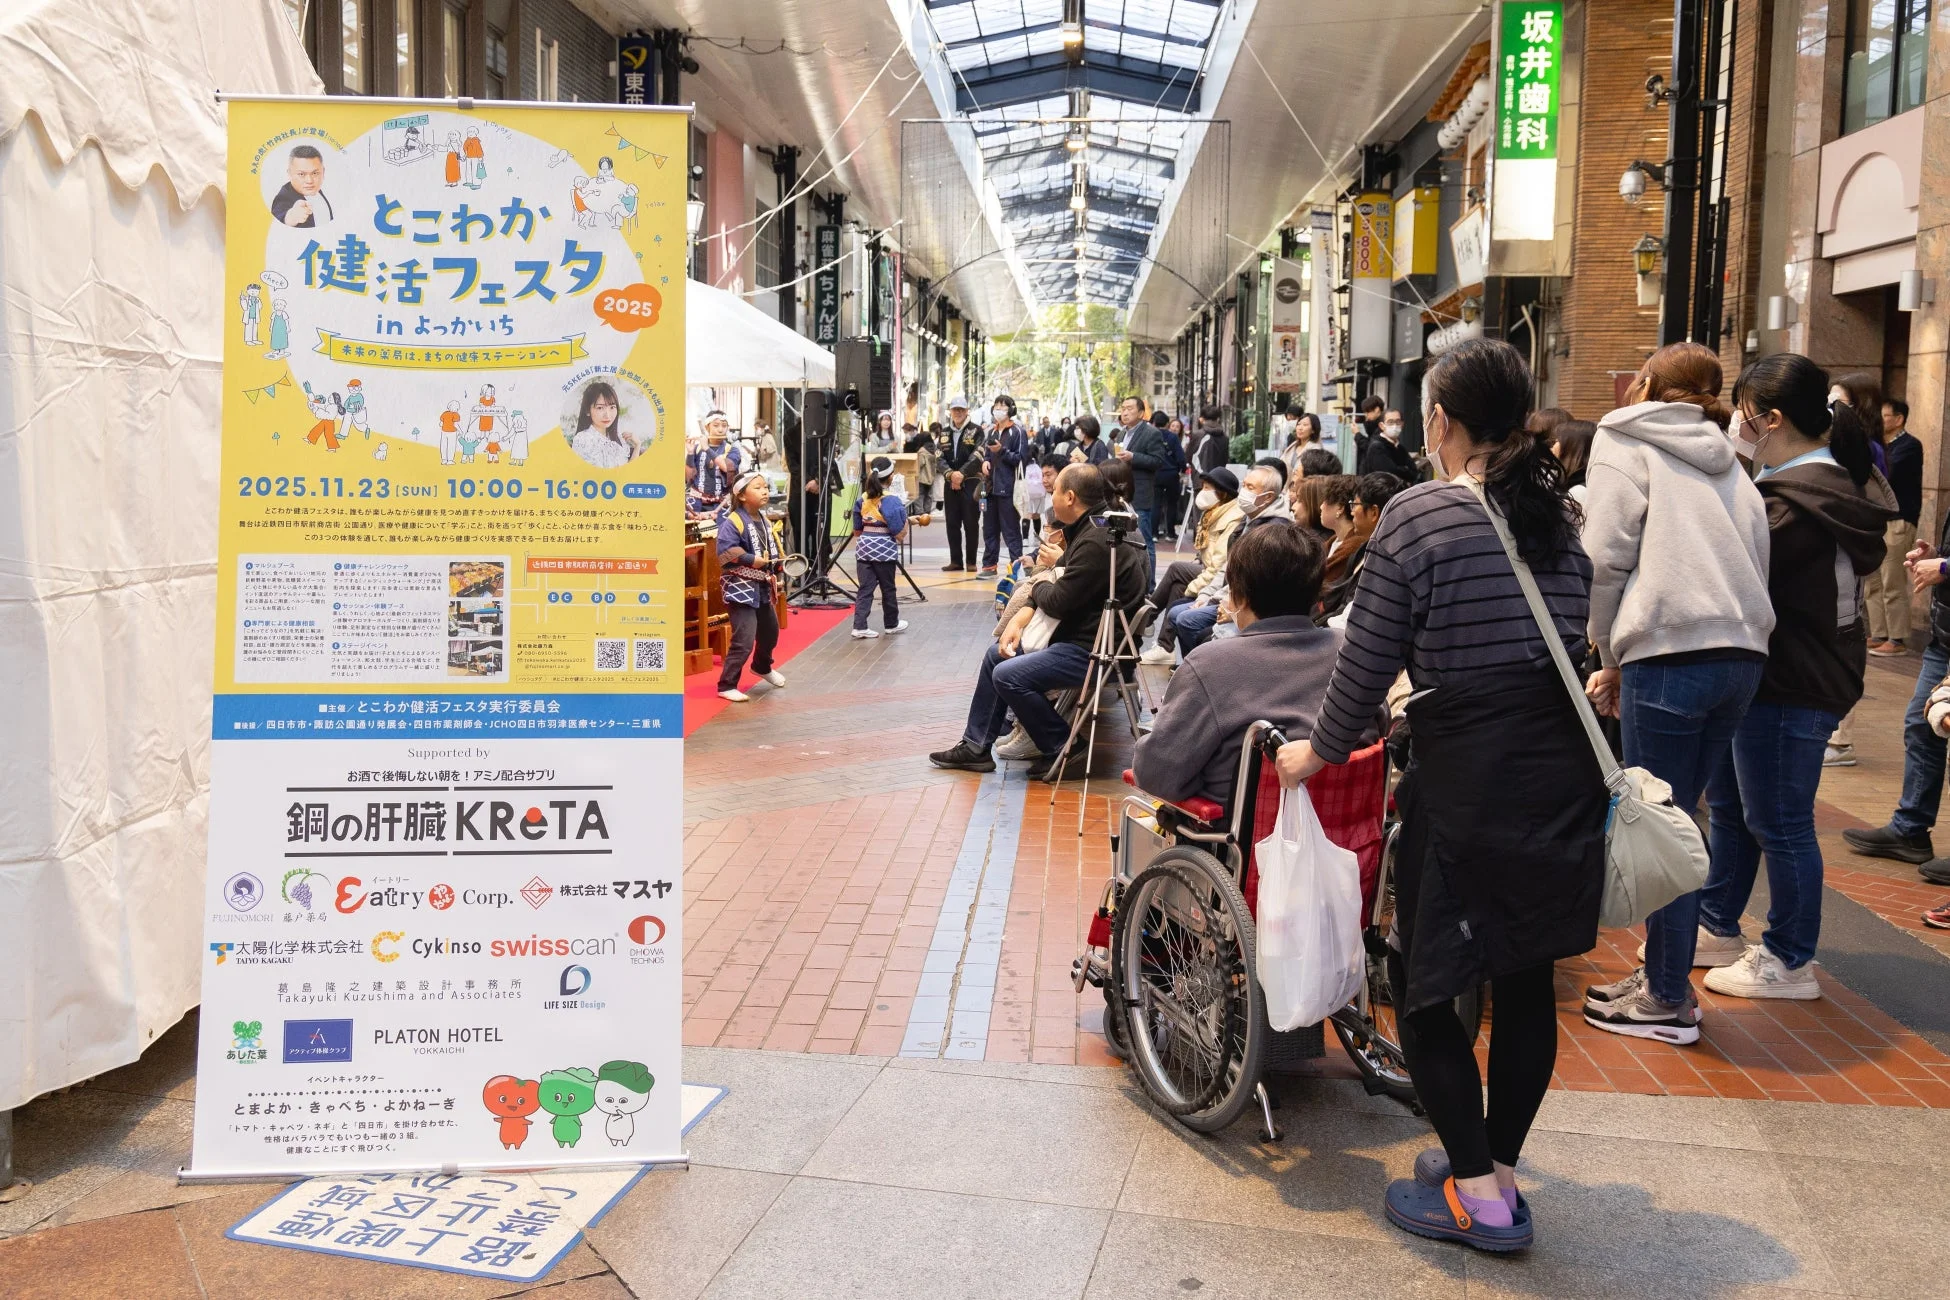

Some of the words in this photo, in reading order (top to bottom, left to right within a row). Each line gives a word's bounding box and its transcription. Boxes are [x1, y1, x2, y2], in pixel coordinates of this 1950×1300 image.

[1516, 10, 1554, 151] 坂井歯科
[373, 193, 553, 245] とこわか
[296, 233, 606, 306] 健活フェスタ
[263, 273, 285, 286] check
[603, 296, 652, 317] 2025
[376, 314, 403, 336] in
[414, 314, 514, 336] よっかいち
[342, 344, 561, 363] 未来の薬局は、まちの健康ステーションへ
[238, 476, 390, 498] 2025.11.23
[396, 485, 438, 498] [SUN]
[617, 561, 648, 570] 公園通り
[408, 747, 471, 760] Supported
[476, 747, 491, 760] by
[286, 801, 447, 842] 鋼の肝臓
[462, 889, 514, 908] Corp.
[560, 884, 608, 897] 株式会社
[612, 879, 673, 899] マスヤ
[212, 913, 274, 923] FUJINOMORI
[283, 912, 328, 923] 藤戸薬局
[236, 939, 364, 956] 太陽化学株式会社
[412, 937, 481, 958] Cykinso
[490, 934, 616, 957] swisscan
[629, 948, 665, 957] DHOWA
[236, 957, 259, 965] TAIYO
[261, 956, 294, 964] KAGAKU
[630, 957, 665, 965] TECHNOS
[278, 993, 337, 1004] Takayuki
[343, 992, 415, 1002] Kuzushima
[421, 991, 444, 1000] and
[451, 990, 522, 1000] Associates
[544, 1000, 559, 1010] LIFE
[562, 1000, 578, 1009] SIZE
[580, 1000, 606, 1010] Design
[374, 1028, 440, 1045] PLATON
[448, 1027, 503, 1043] HOTEL
[226, 1049, 268, 1060] あした葉
[413, 1046, 465, 1055] YOKKAICHI
[307, 1075, 384, 1084] イベントキャラクター
[286, 1143, 397, 1155] 健康なことにすぐ飛びつく。
[308, 1184, 562, 1237] 禁止区域
[268, 1209, 532, 1268] 路上喫煙
